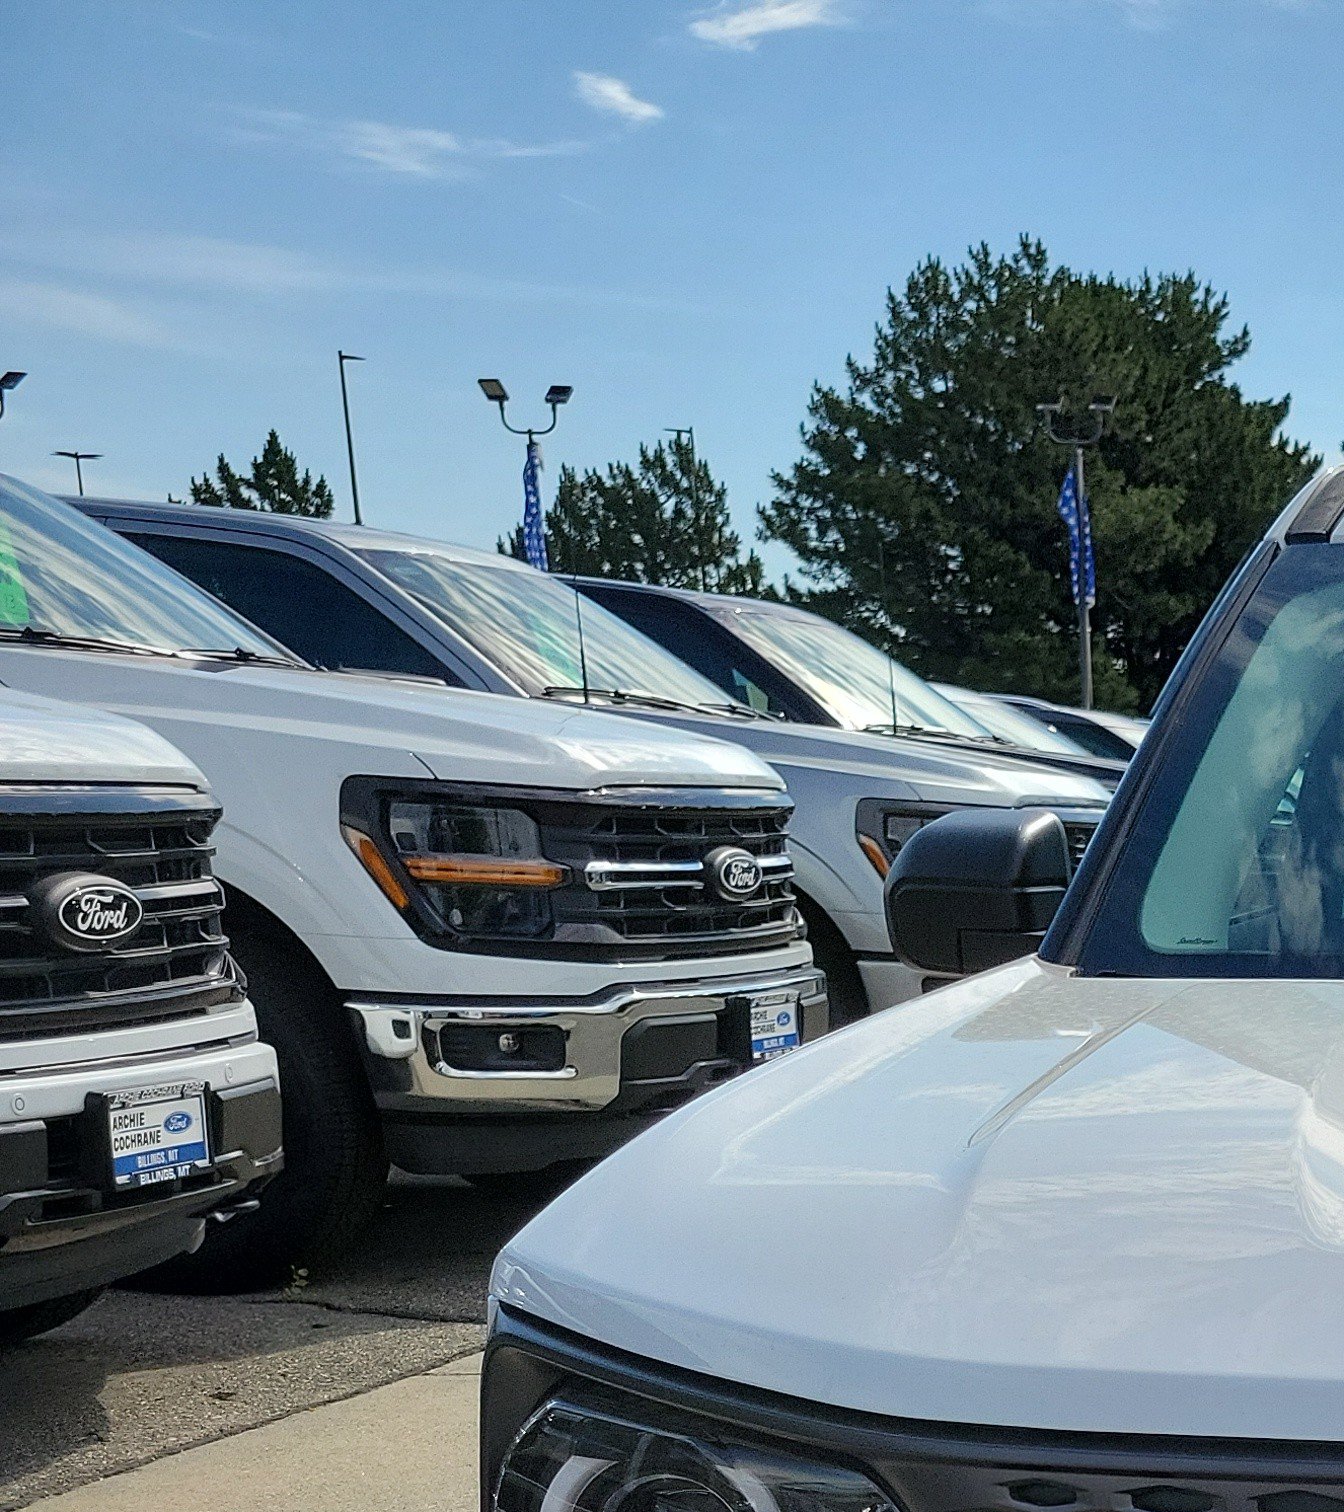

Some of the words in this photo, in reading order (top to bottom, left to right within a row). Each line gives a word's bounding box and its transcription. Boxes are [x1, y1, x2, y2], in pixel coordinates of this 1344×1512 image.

[729, 861, 756, 887] Ford
[77, 894, 128, 931] Ford
[112, 1112, 145, 1132] ARCHIE
[168, 1114, 187, 1131] Ford
[113, 1130, 162, 1152] COCHRANE
[168, 1148, 179, 1163] MT
[140, 1167, 177, 1185] BILLINGS,
[178, 1164, 191, 1178] MT
